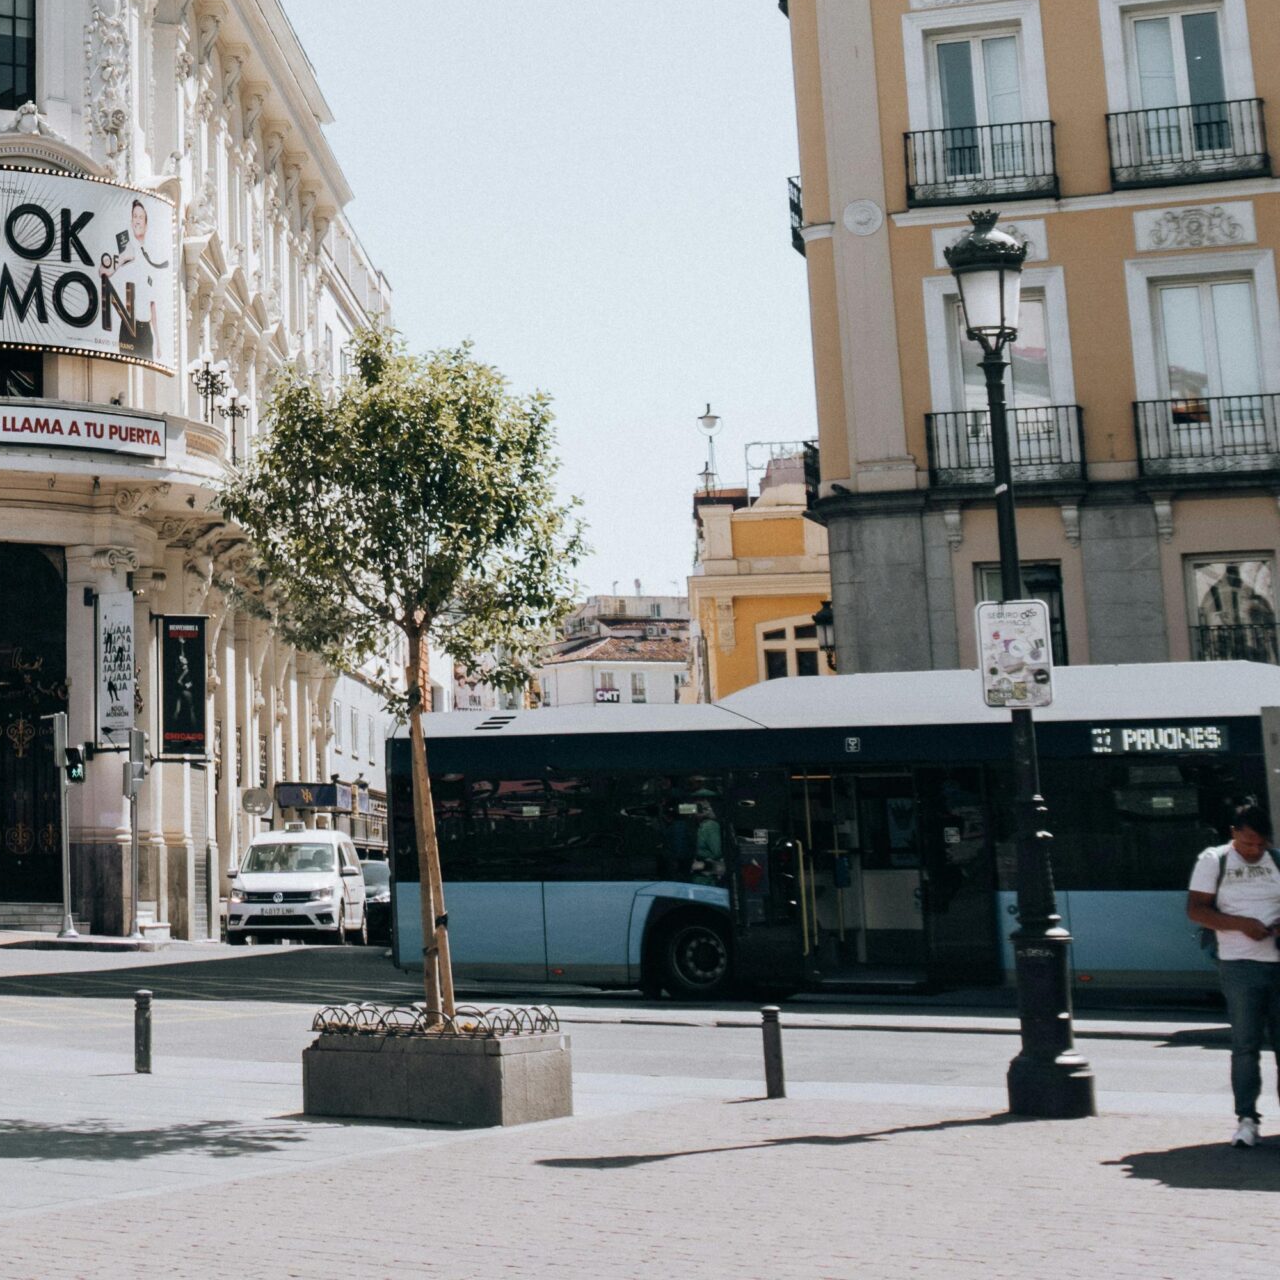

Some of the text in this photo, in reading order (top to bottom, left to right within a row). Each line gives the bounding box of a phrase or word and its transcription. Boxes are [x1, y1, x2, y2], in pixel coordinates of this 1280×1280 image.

[101, 253, 119, 270] OF
[2, 416, 64, 435] LLAMA
[68, 420, 81, 436] A
[85, 422, 104, 438] TU
[109, 425, 161, 446] PUERTA
[596, 690, 620, 702] CNT
